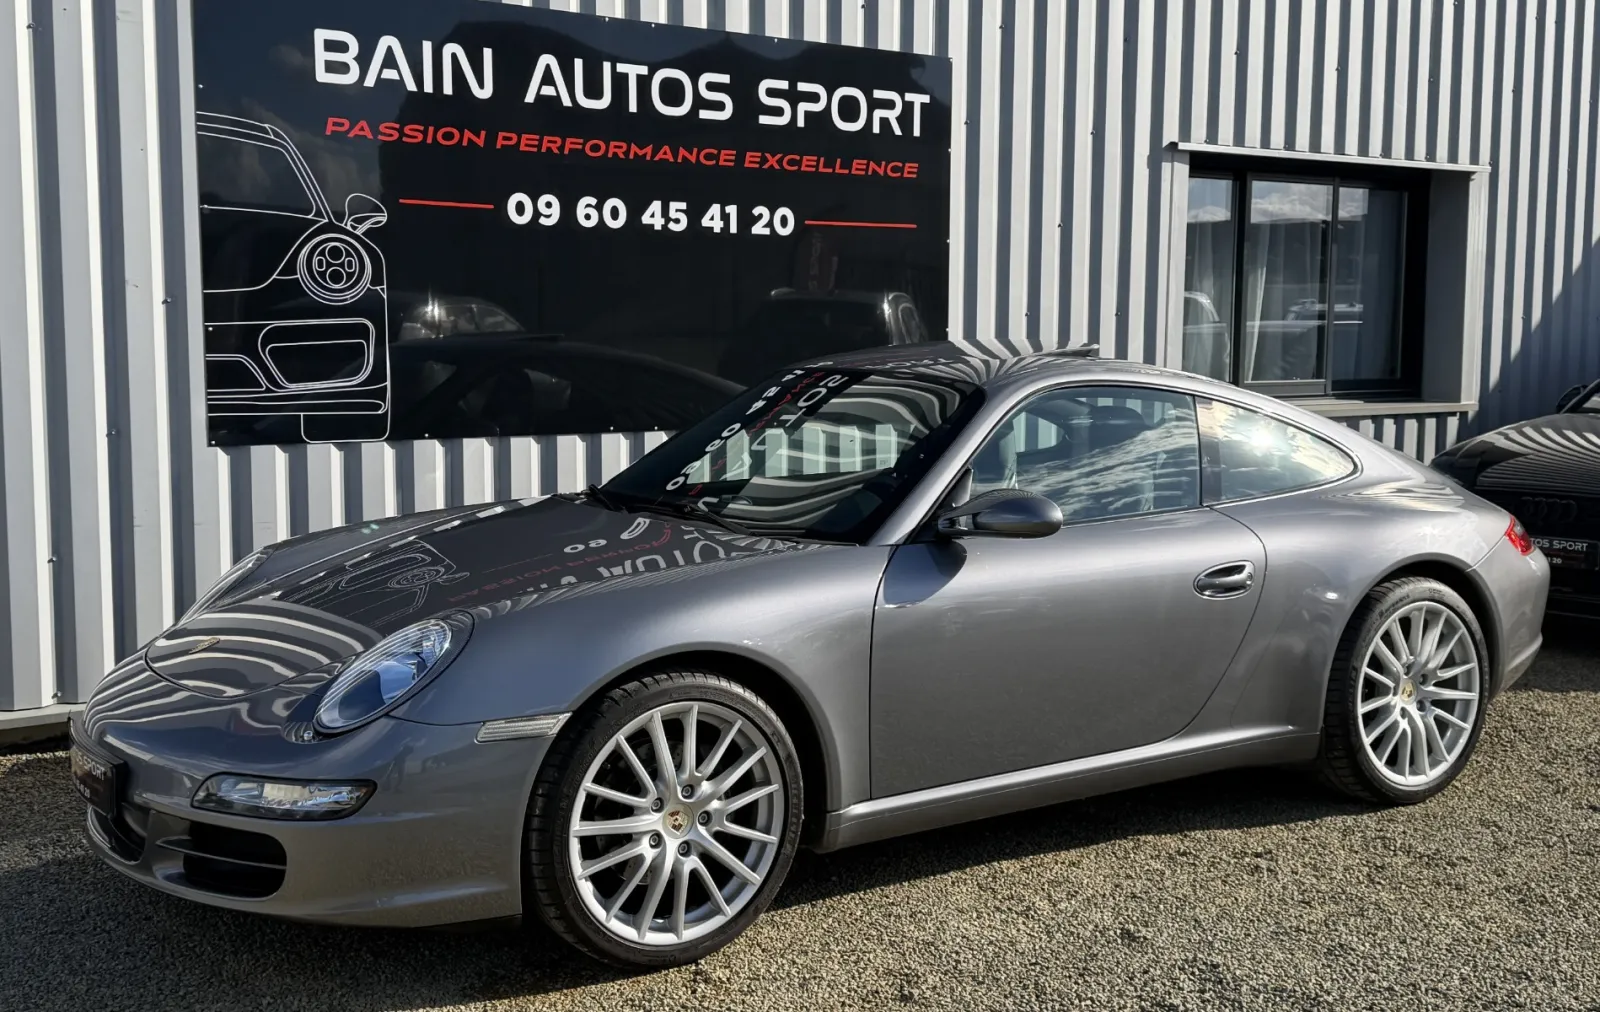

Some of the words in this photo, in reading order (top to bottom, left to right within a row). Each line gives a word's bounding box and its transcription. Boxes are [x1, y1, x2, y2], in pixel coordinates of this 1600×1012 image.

[313, 28, 494, 100] BAIN
[523, 53, 734, 121] AUTOS
[757, 78, 931, 137] SPORT
[325, 117, 487, 147] PASSION
[496, 131, 737, 167] PERFORMANCE
[744, 151, 919, 179] EXCELLENCE
[506, 192, 561, 226] 09
[576, 195, 627, 229] 60
[641, 200, 688, 232] 45
[700, 203, 738, 234] 41
[751, 205, 795, 236] 20
[1553, 540, 1588, 551] SPORT
[83, 756, 105, 780] SPORT
